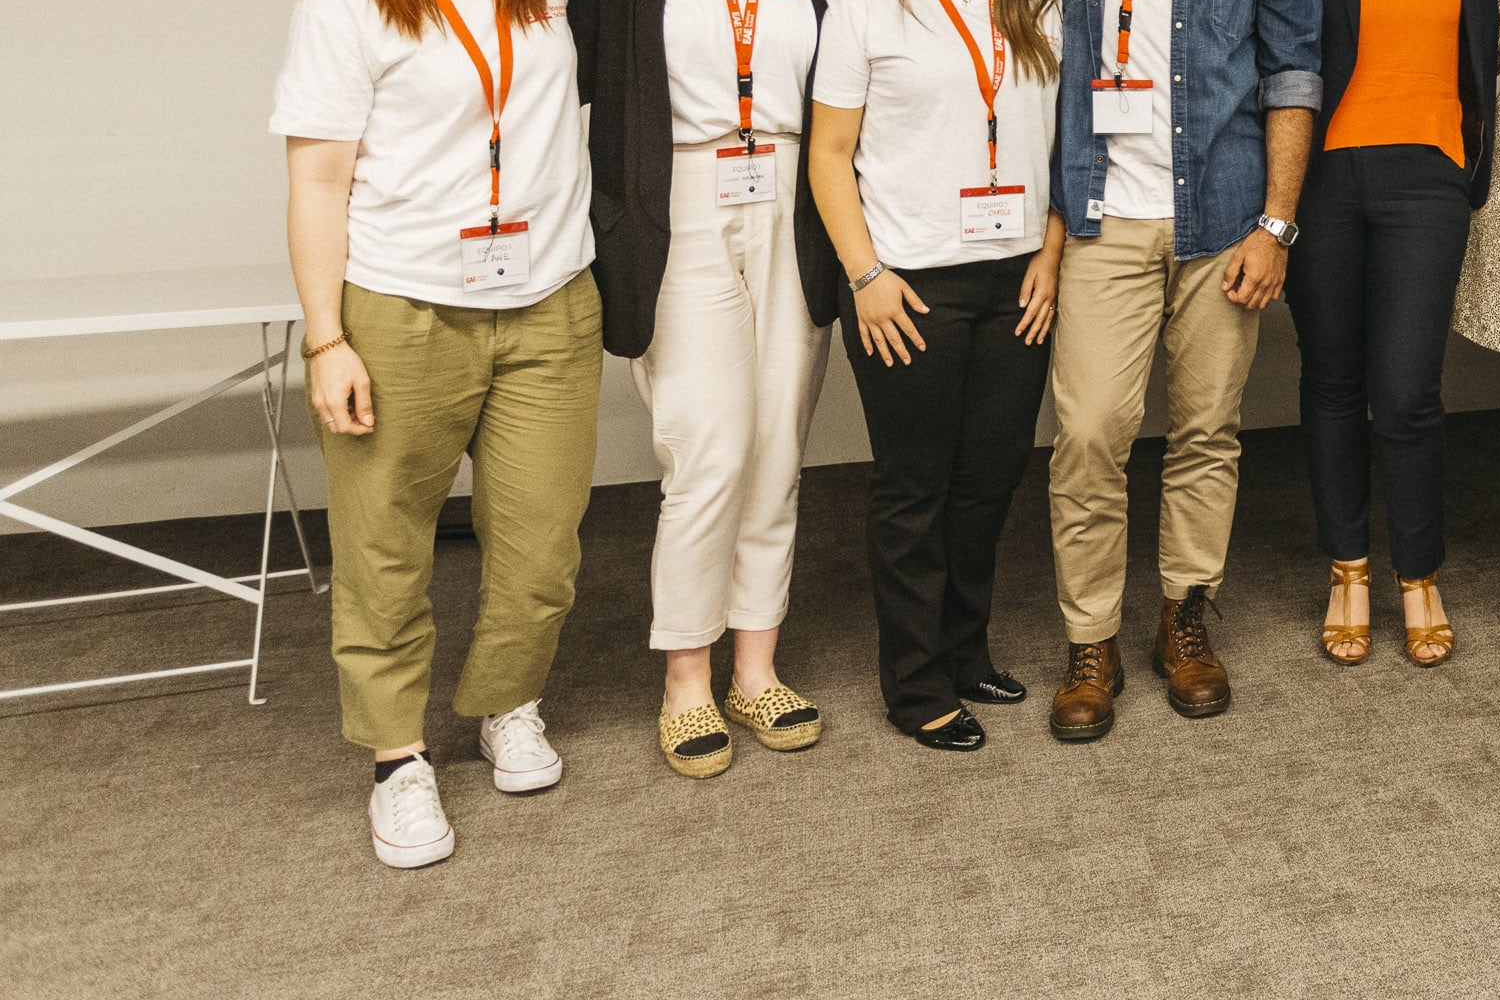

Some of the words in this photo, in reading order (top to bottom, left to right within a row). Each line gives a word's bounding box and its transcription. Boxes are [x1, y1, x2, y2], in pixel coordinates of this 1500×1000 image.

[731, 11, 742, 27] EAE
[742, 27, 753, 45] EAE
[993, 35, 1003, 51] EAE
